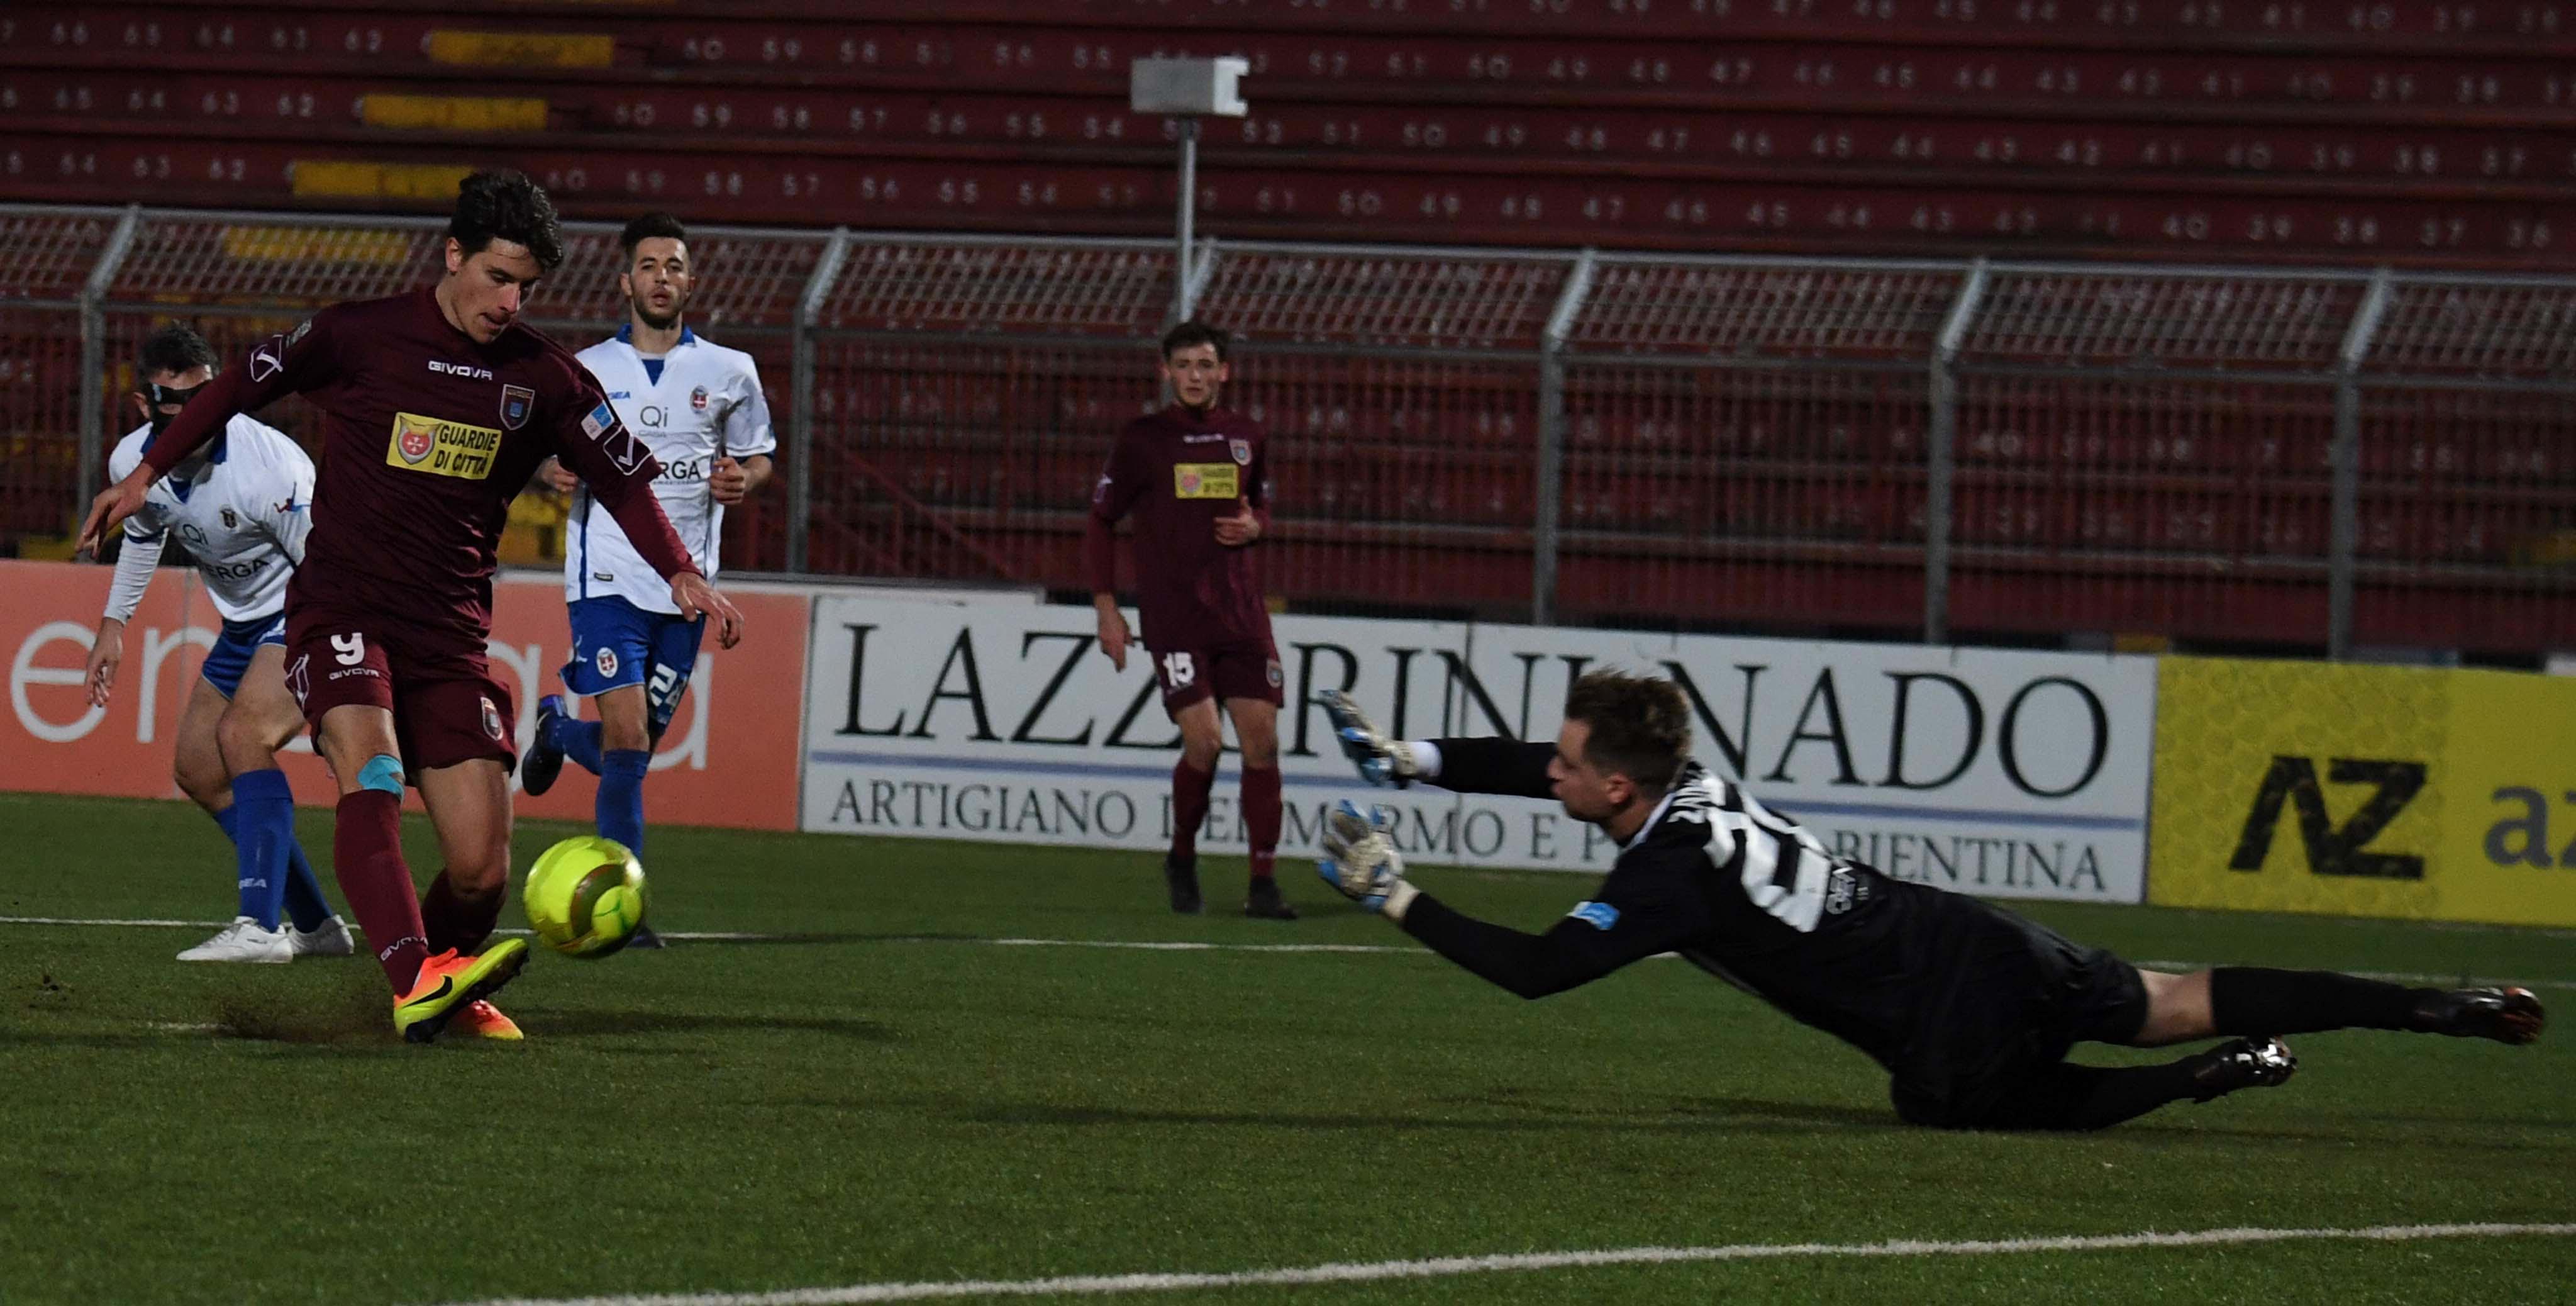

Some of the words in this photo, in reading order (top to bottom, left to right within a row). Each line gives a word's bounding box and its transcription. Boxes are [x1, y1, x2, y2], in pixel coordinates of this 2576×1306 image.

[428, 359, 493, 381] GIVOVA
[640, 406, 669, 428] Qi
[440, 425, 498, 452] GUARDIE
[434, 450, 451, 470] DI
[182, 523, 209, 545] Qi
[330, 632, 365, 666] 9
[1163, 651, 1196, 688] 15
[831, 779, 1136, 839] ARTIGIANO
[1282, 801, 1504, 857] MRMO
[2229, 754, 2428, 880] AZ
[2485, 784, 2576, 869] a
